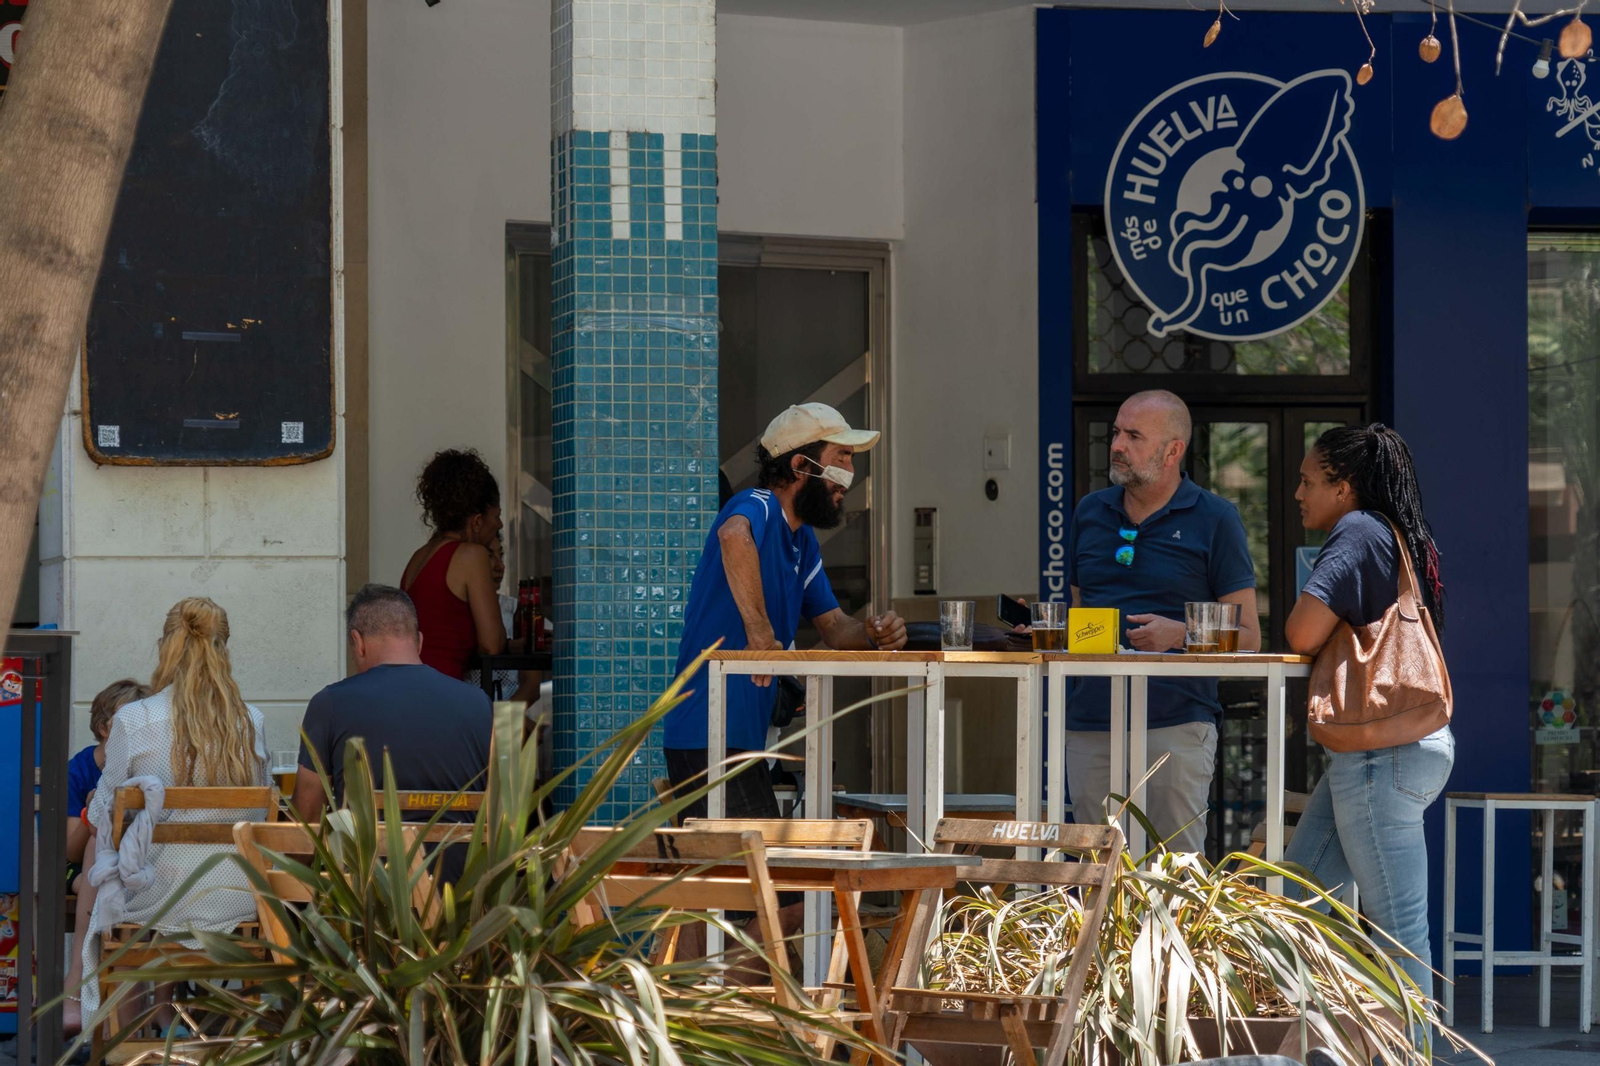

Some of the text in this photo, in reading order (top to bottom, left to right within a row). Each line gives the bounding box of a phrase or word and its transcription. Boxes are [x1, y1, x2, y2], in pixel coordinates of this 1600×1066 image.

[1123, 94, 1239, 204] HUELVA
[1142, 218, 1163, 251] de
[1260, 189, 1352, 310] CHOCO
[1210, 288, 1249, 311] que
[1220, 308, 1249, 327] un
[992, 822, 1060, 842] HUELVA
